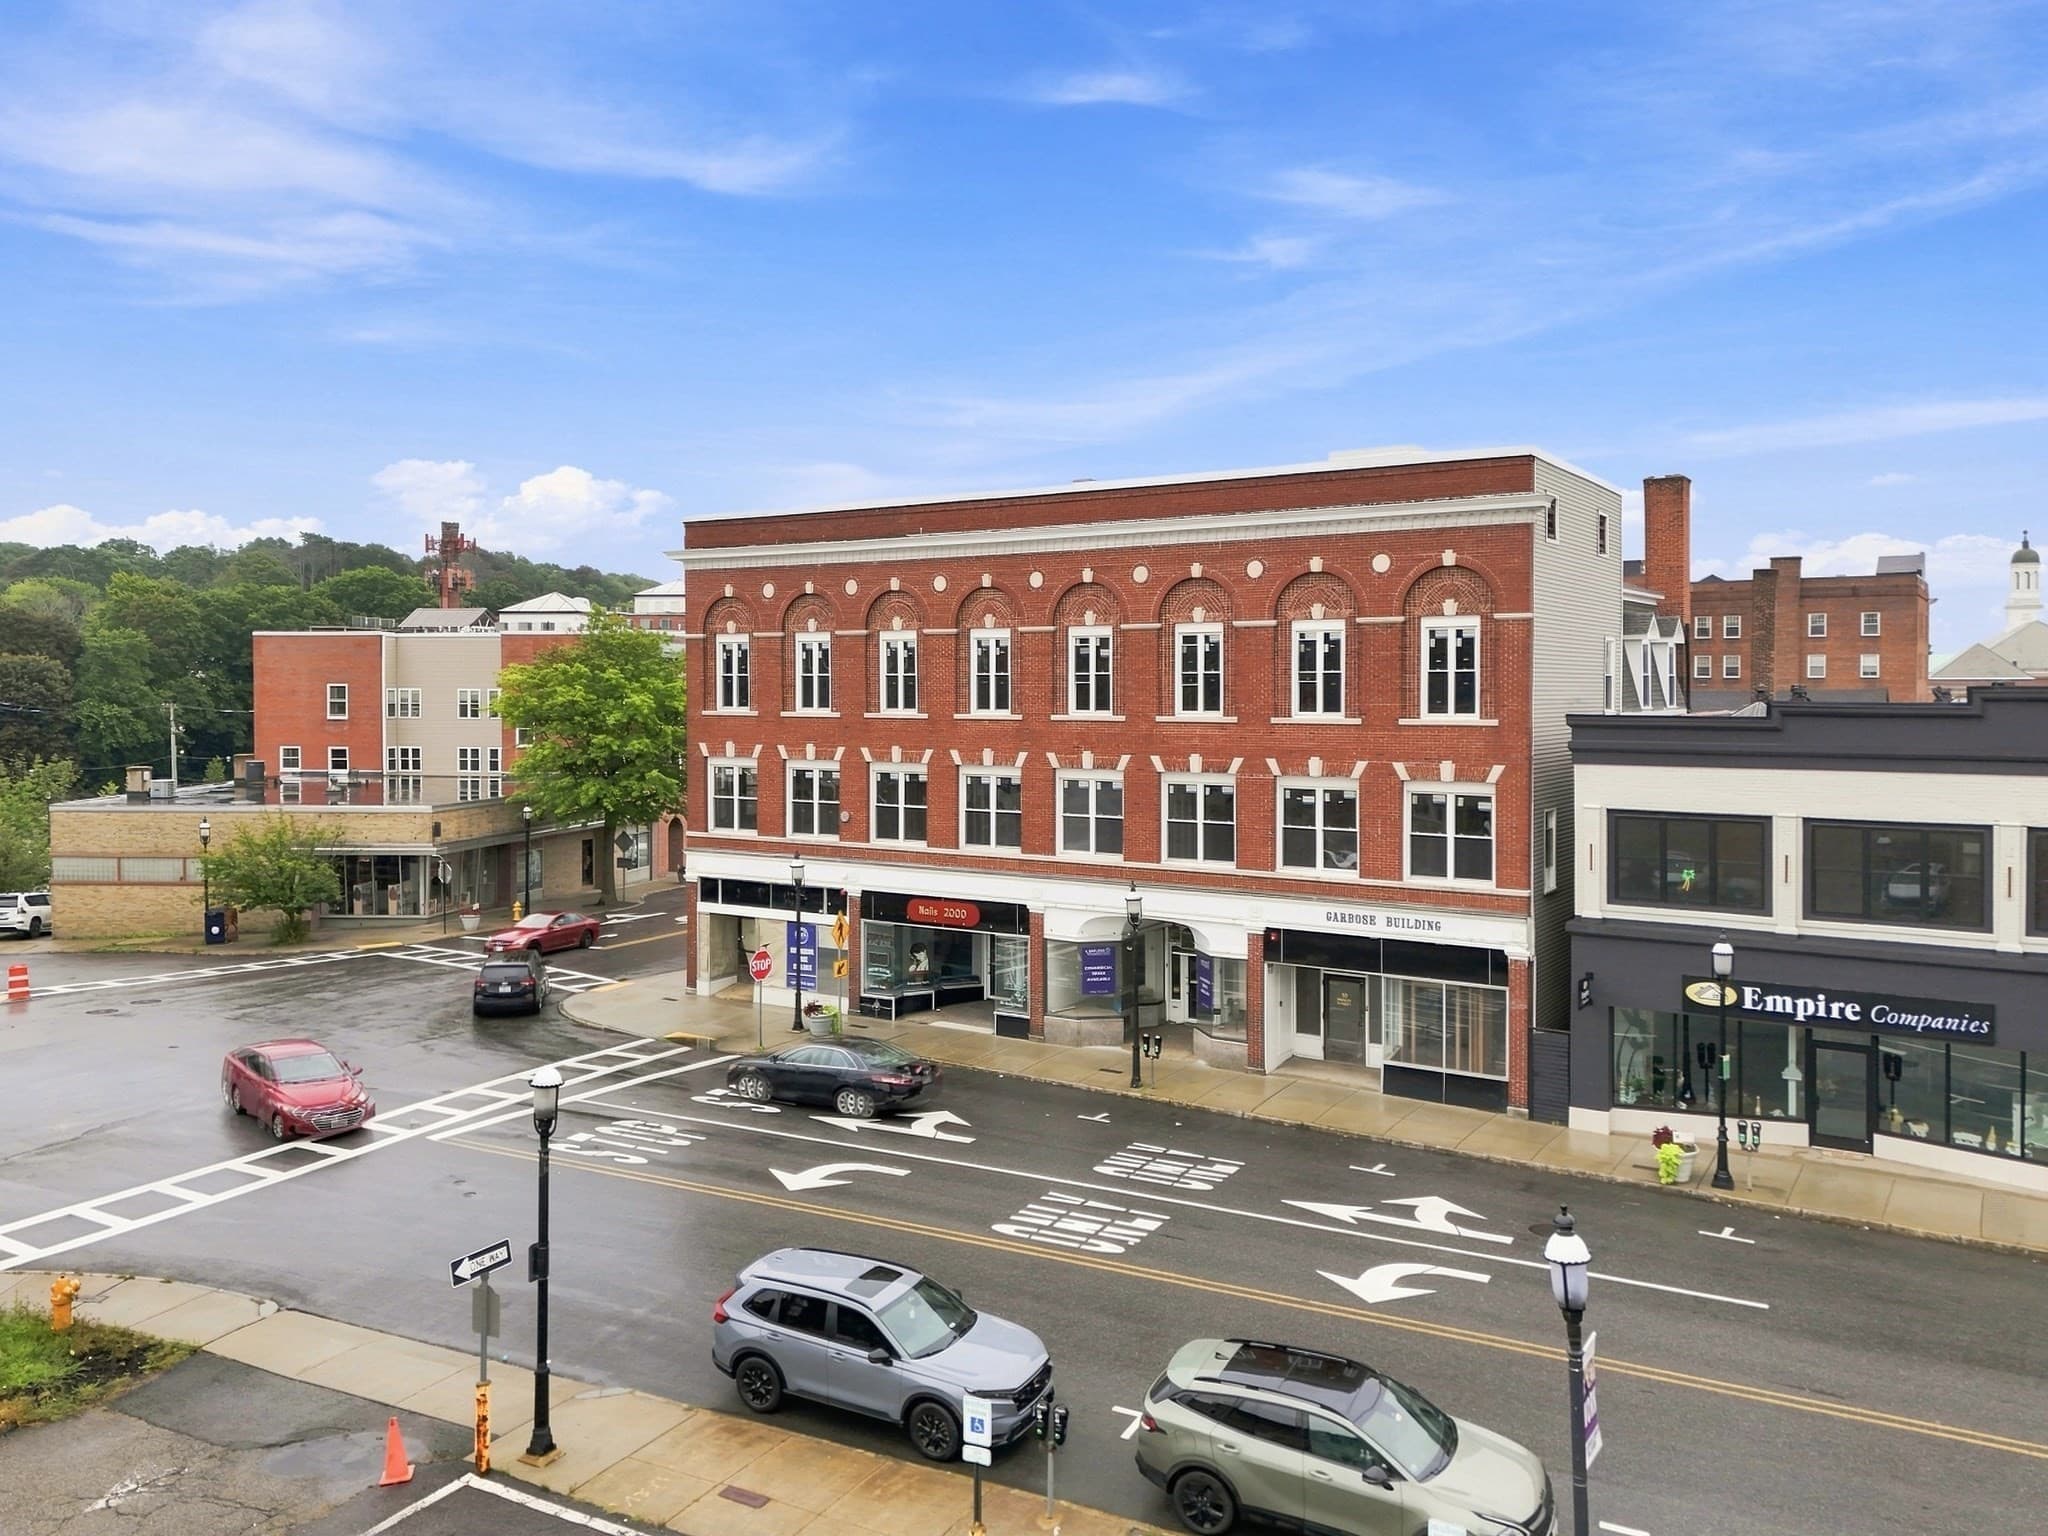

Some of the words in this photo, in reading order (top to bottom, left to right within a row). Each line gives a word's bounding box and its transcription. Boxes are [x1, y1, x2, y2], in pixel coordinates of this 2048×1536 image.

[918, 905, 939, 916] Nails
[943, 907, 967, 919] 2000
[1326, 911, 1377, 925] GARBOSE
[1386, 917, 1442, 931] BUILDING
[752, 958, 771, 972] STOP
[1741, 985, 1862, 1022] Empire
[1870, 1004, 1990, 1035] Companies
[549, 1119, 707, 1165] STOP
[1093, 1142, 1246, 1191] ONLY
[990, 1191, 1171, 1254] ONLY
[470, 1256, 487, 1271] ONE
[489, 1249, 505, 1263] WAY
